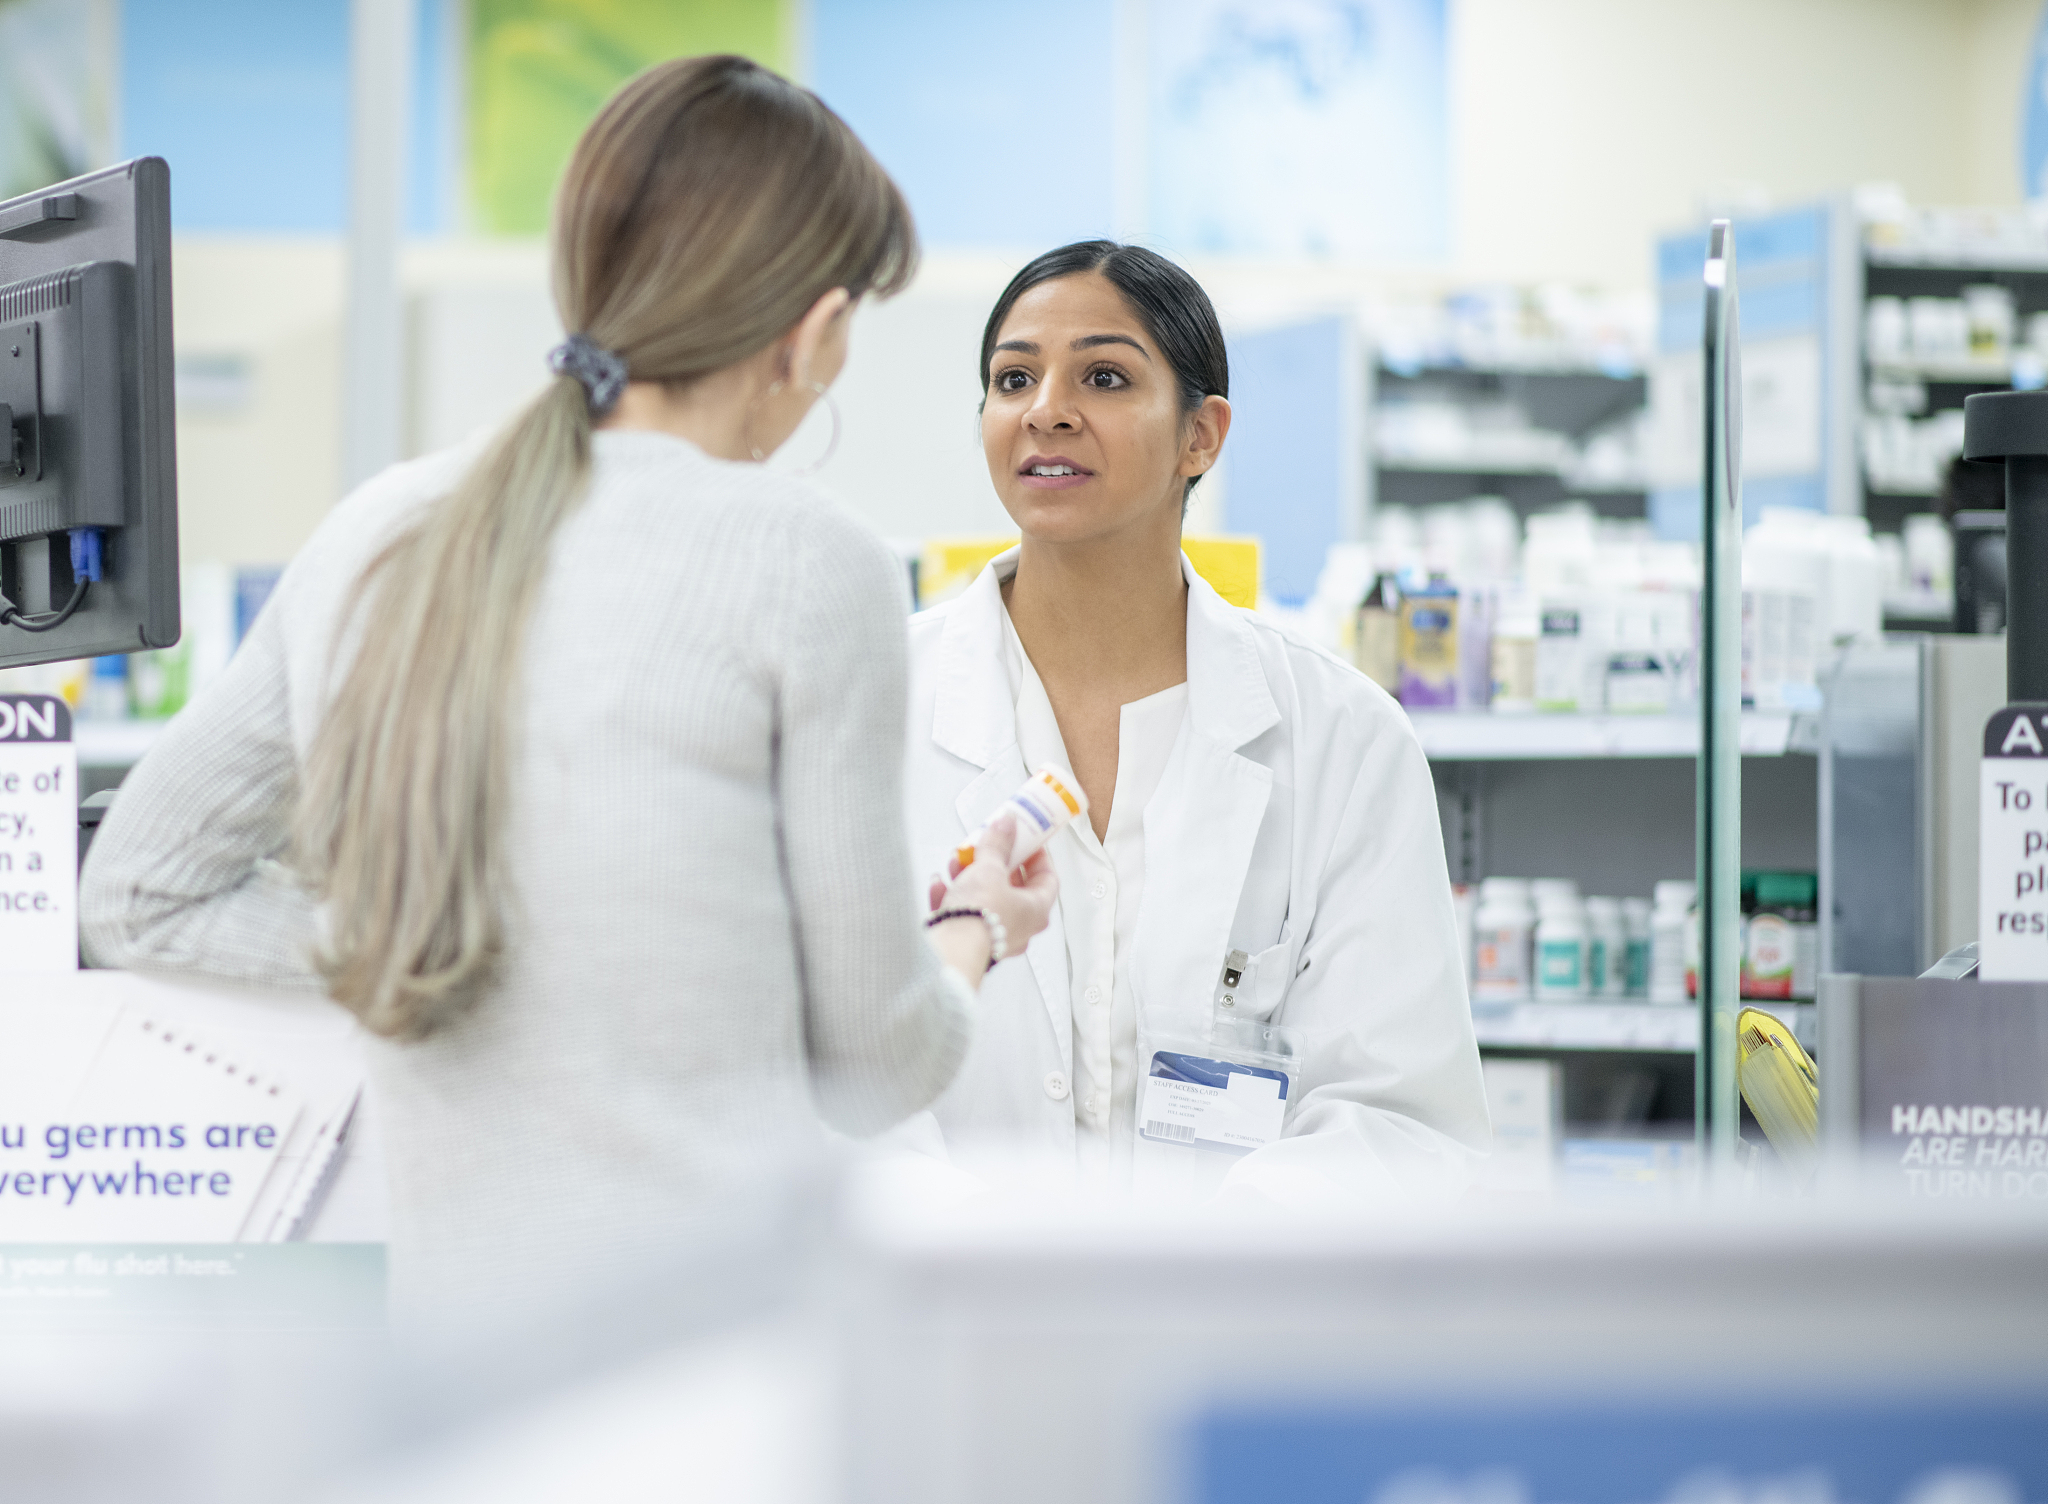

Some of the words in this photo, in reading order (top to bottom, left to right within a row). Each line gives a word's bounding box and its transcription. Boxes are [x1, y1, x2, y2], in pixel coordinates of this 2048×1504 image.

[2001, 714, 2048, 754] A
[0, 772, 19, 793] e
[34, 765, 61, 793] of
[1995, 781, 2031, 811] To
[2025, 831, 2048, 859] p
[27, 852, 42, 871] a
[2017, 864, 2048, 899] pl
[1997, 912, 2048, 934] res
[1153, 1080, 1173, 1089] STAFF
[1173, 1083, 1199, 1093] ACCESS
[1199, 1088, 1219, 1097] CARD
[45, 1124, 186, 1159] germs
[205, 1124, 277, 1148] are
[1900, 1136, 1968, 1165] ARE
[1974, 1138, 2048, 1167] HAR
[1904, 1168, 1992, 1198] TURN
[9, 1258, 67, 1280] your
[73, 1252, 108, 1275] flu
[114, 1252, 169, 1275] shot
